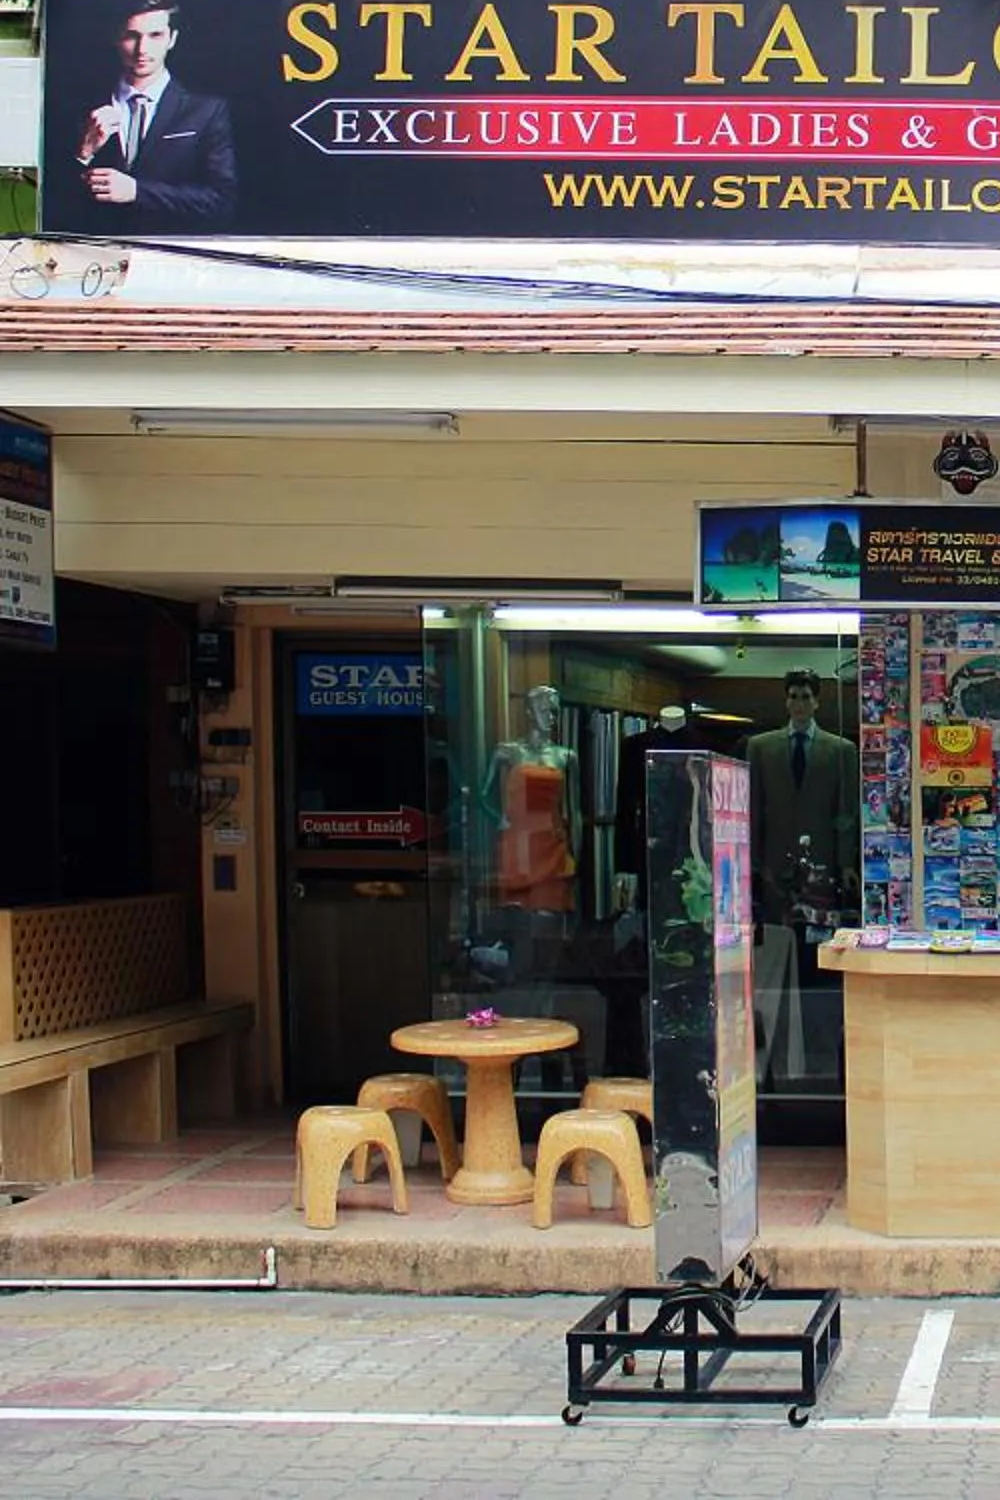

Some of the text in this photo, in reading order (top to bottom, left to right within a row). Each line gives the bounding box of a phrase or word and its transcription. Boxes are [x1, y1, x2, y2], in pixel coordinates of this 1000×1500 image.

[281, 3, 626, 84] STAR
[333, 109, 637, 147] EXCLUSIVE
[676, 111, 871, 150] LADIES
[901, 116, 937, 149] &
[867, 547, 913, 563] STAR
[919, 548, 985, 565] TRAVEL
[309, 691, 368, 706] GUEST
[303, 819, 412, 833] Contact Inside
